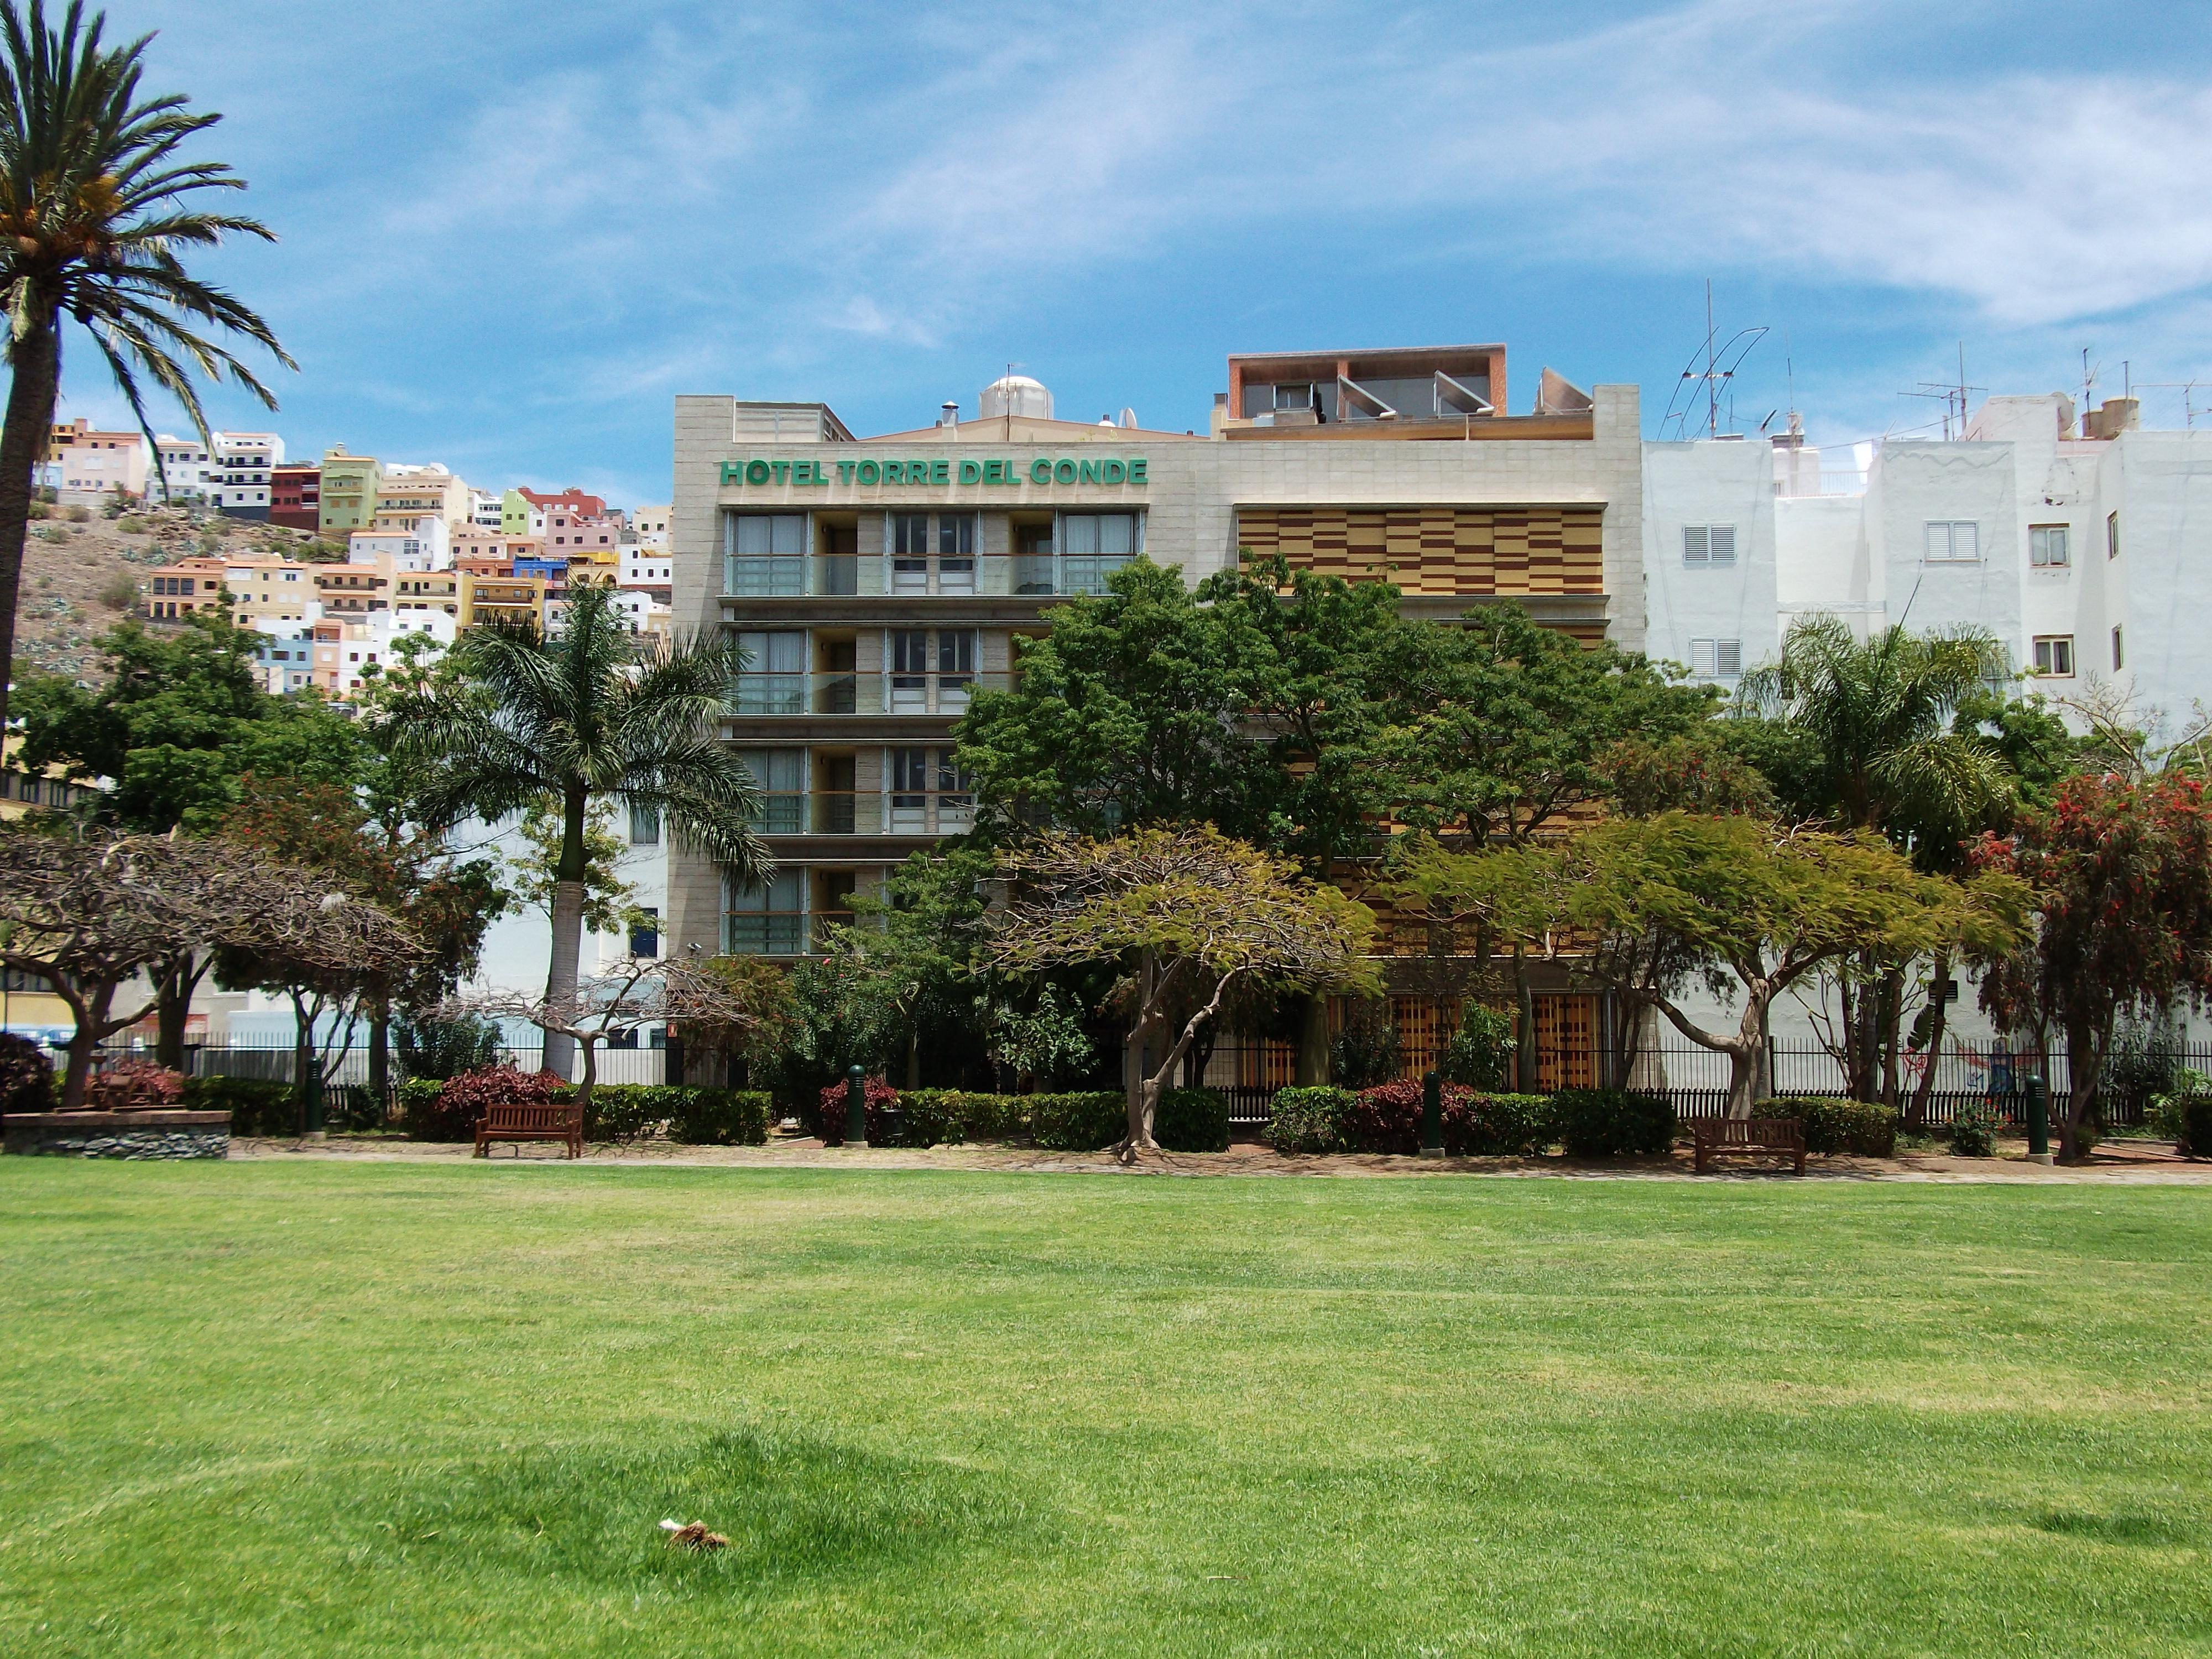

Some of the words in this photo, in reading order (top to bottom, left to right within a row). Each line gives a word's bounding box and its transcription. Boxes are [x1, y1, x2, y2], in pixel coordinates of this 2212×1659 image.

[720, 460, 829, 486] HOTEL
[837, 460, 950, 486] TORRE
[958, 459, 1021, 485] DEL
[1030, 458, 1149, 484] CONDE
